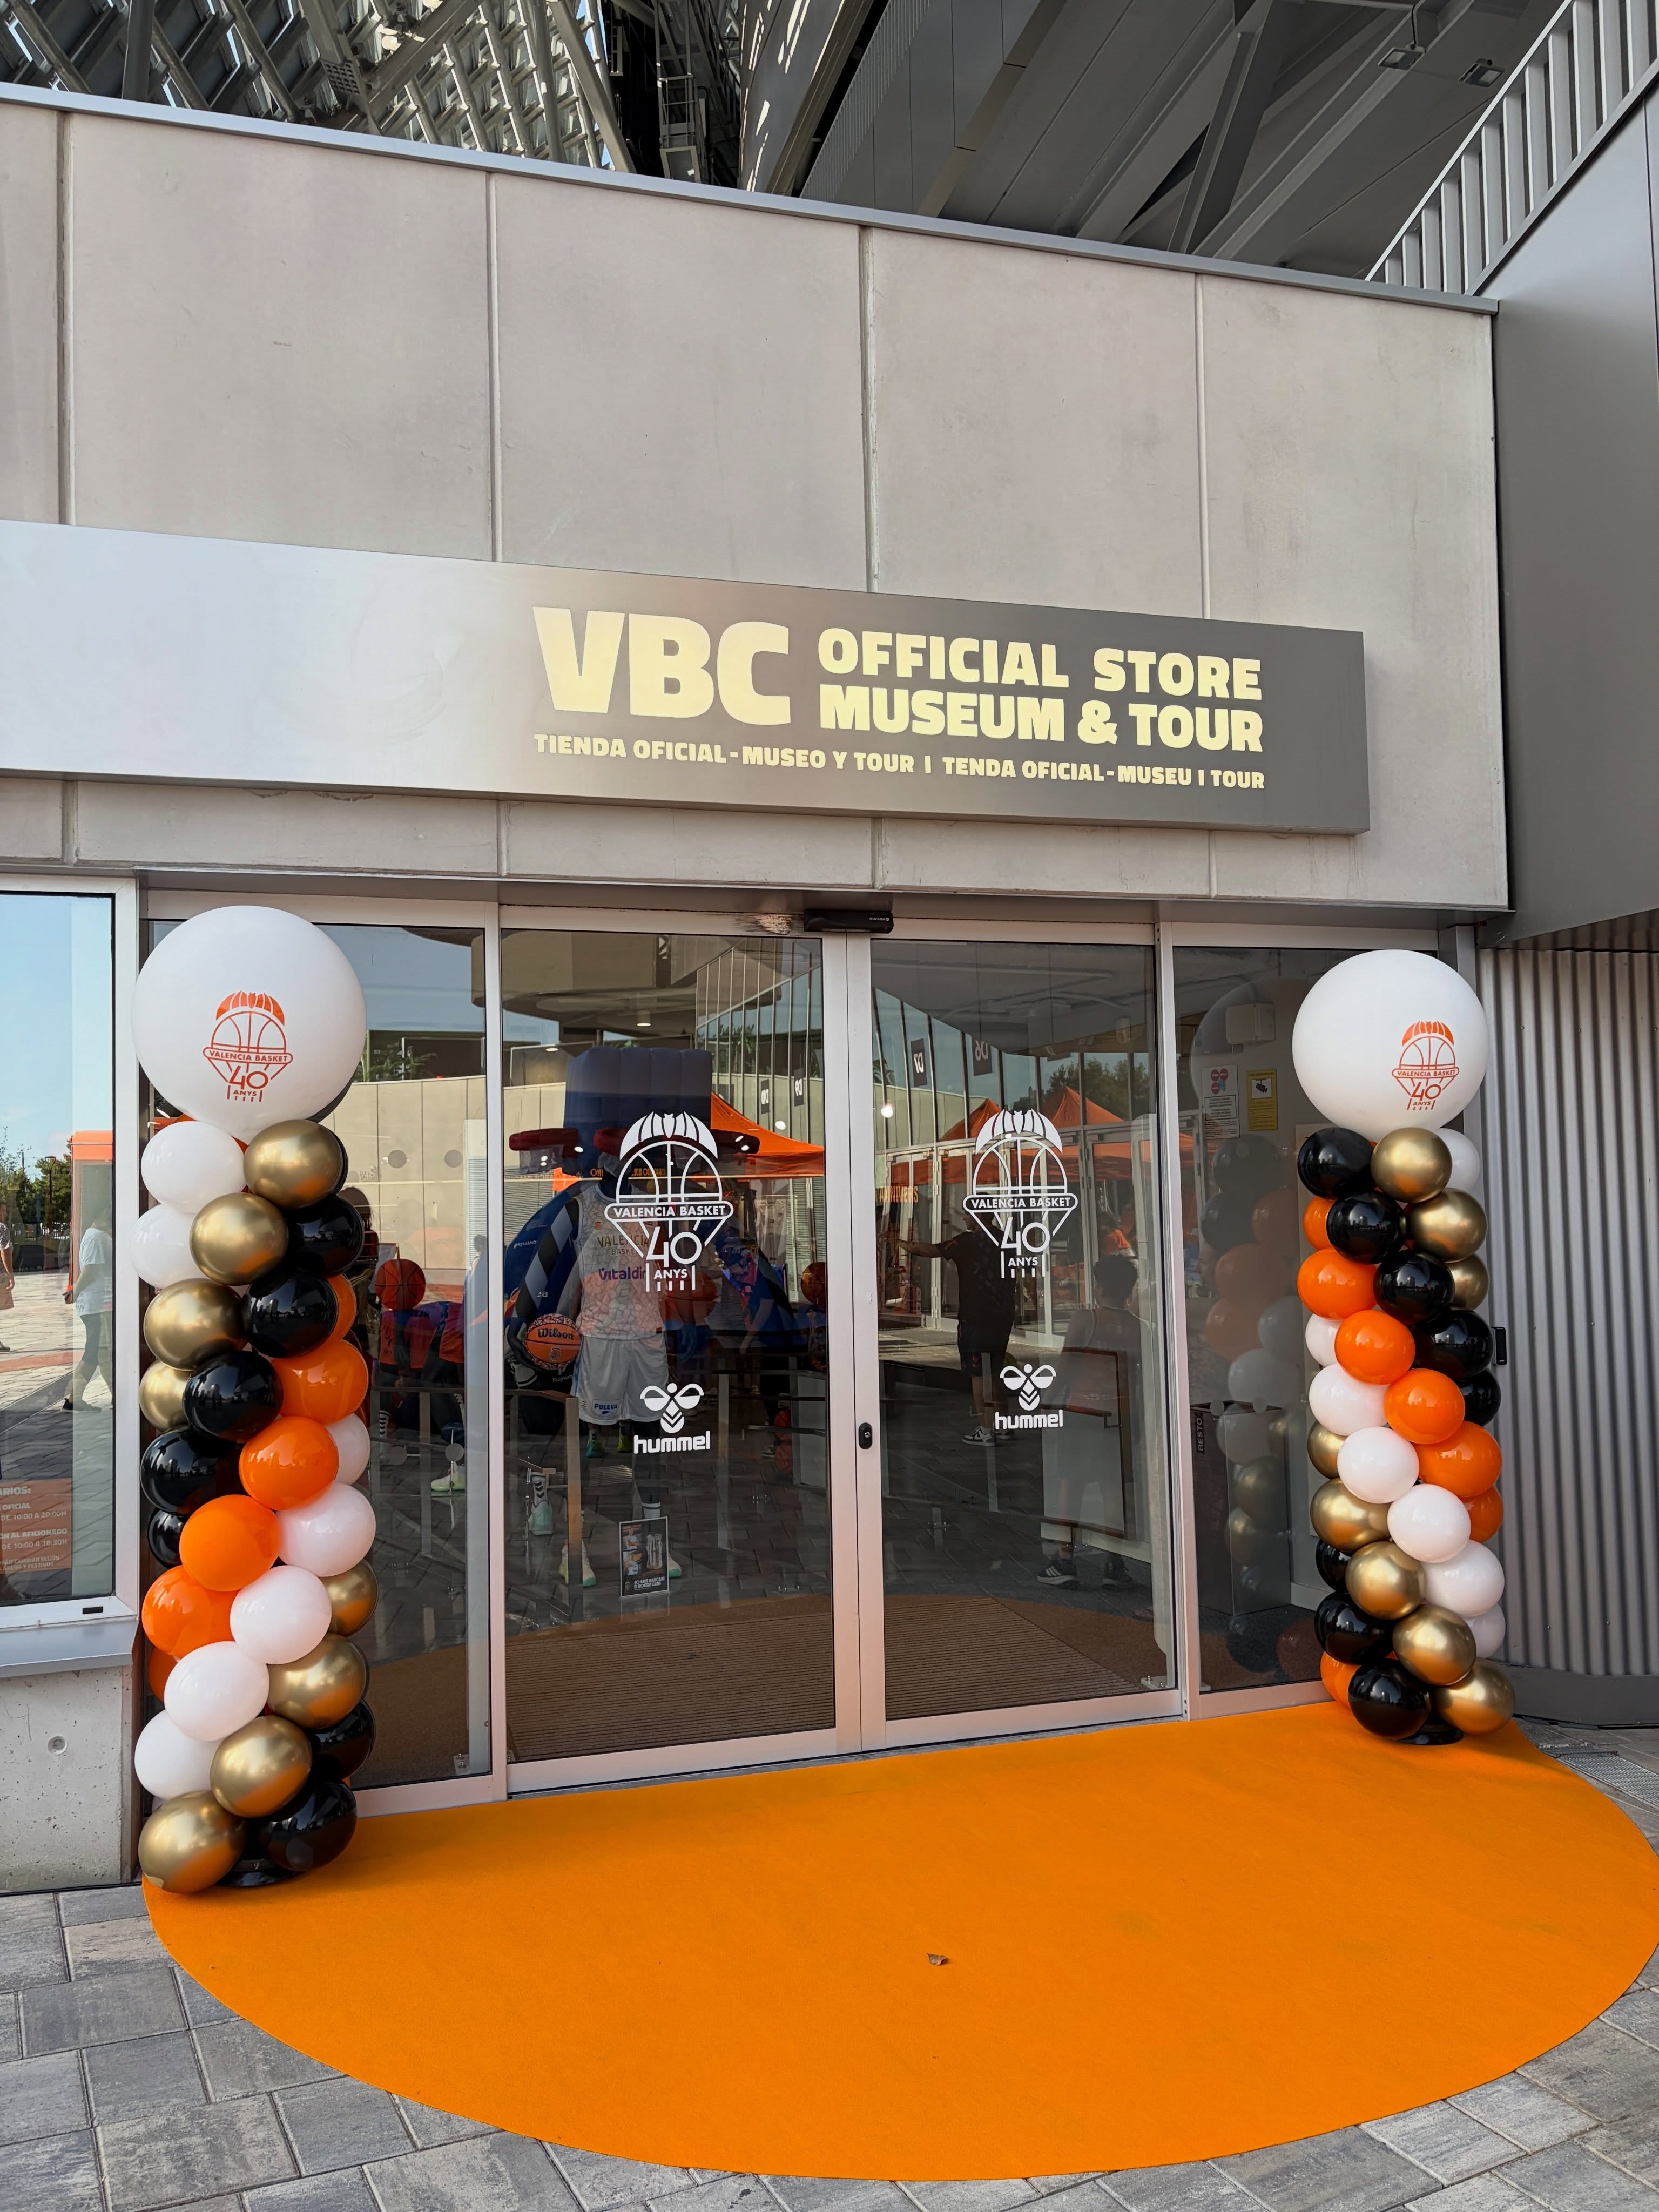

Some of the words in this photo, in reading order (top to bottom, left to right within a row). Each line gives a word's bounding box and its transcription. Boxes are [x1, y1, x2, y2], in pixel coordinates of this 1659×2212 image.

[532, 606, 791, 725] VBC
[818, 628, 1069, 688] OFFICIAL
[1093, 648, 1262, 700] STORE
[820, 684, 1065, 741] MUSEUM
[1077, 700, 1118, 745] &
[1128, 703, 1263, 752] TOUR
[534, 734, 627, 758] TIENDA
[832, 751, 847, 769] Y
[854, 752, 914, 773] TOUR
[943, 757, 1016, 778] TENDA
[1210, 770, 1265, 789] TOUR
[209, 1049, 252, 1061] VALENCIA
[229, 1065, 269, 1090] 40
[1411, 1081, 1441, 1101] 40
[613, 1206, 676, 1217] VALENCIA
[679, 1205, 726, 1216] BASKET
[971, 1198, 1026, 1209] VALENCIA
[1030, 1197, 1071, 1208] BASKET
[646, 1226, 702, 1267] 40
[1000, 1217, 1050, 1256] 40
[1008, 1257, 1038, 1266] ANYS
[653, 1269, 688, 1279] ANYS
[538, 1328, 574, 1340] Wilson
[995, 1409, 1063, 1429] hummel
[633, 1431, 711, 1454] hummel
[22, 1528, 68, 1537] AFICIONADO
